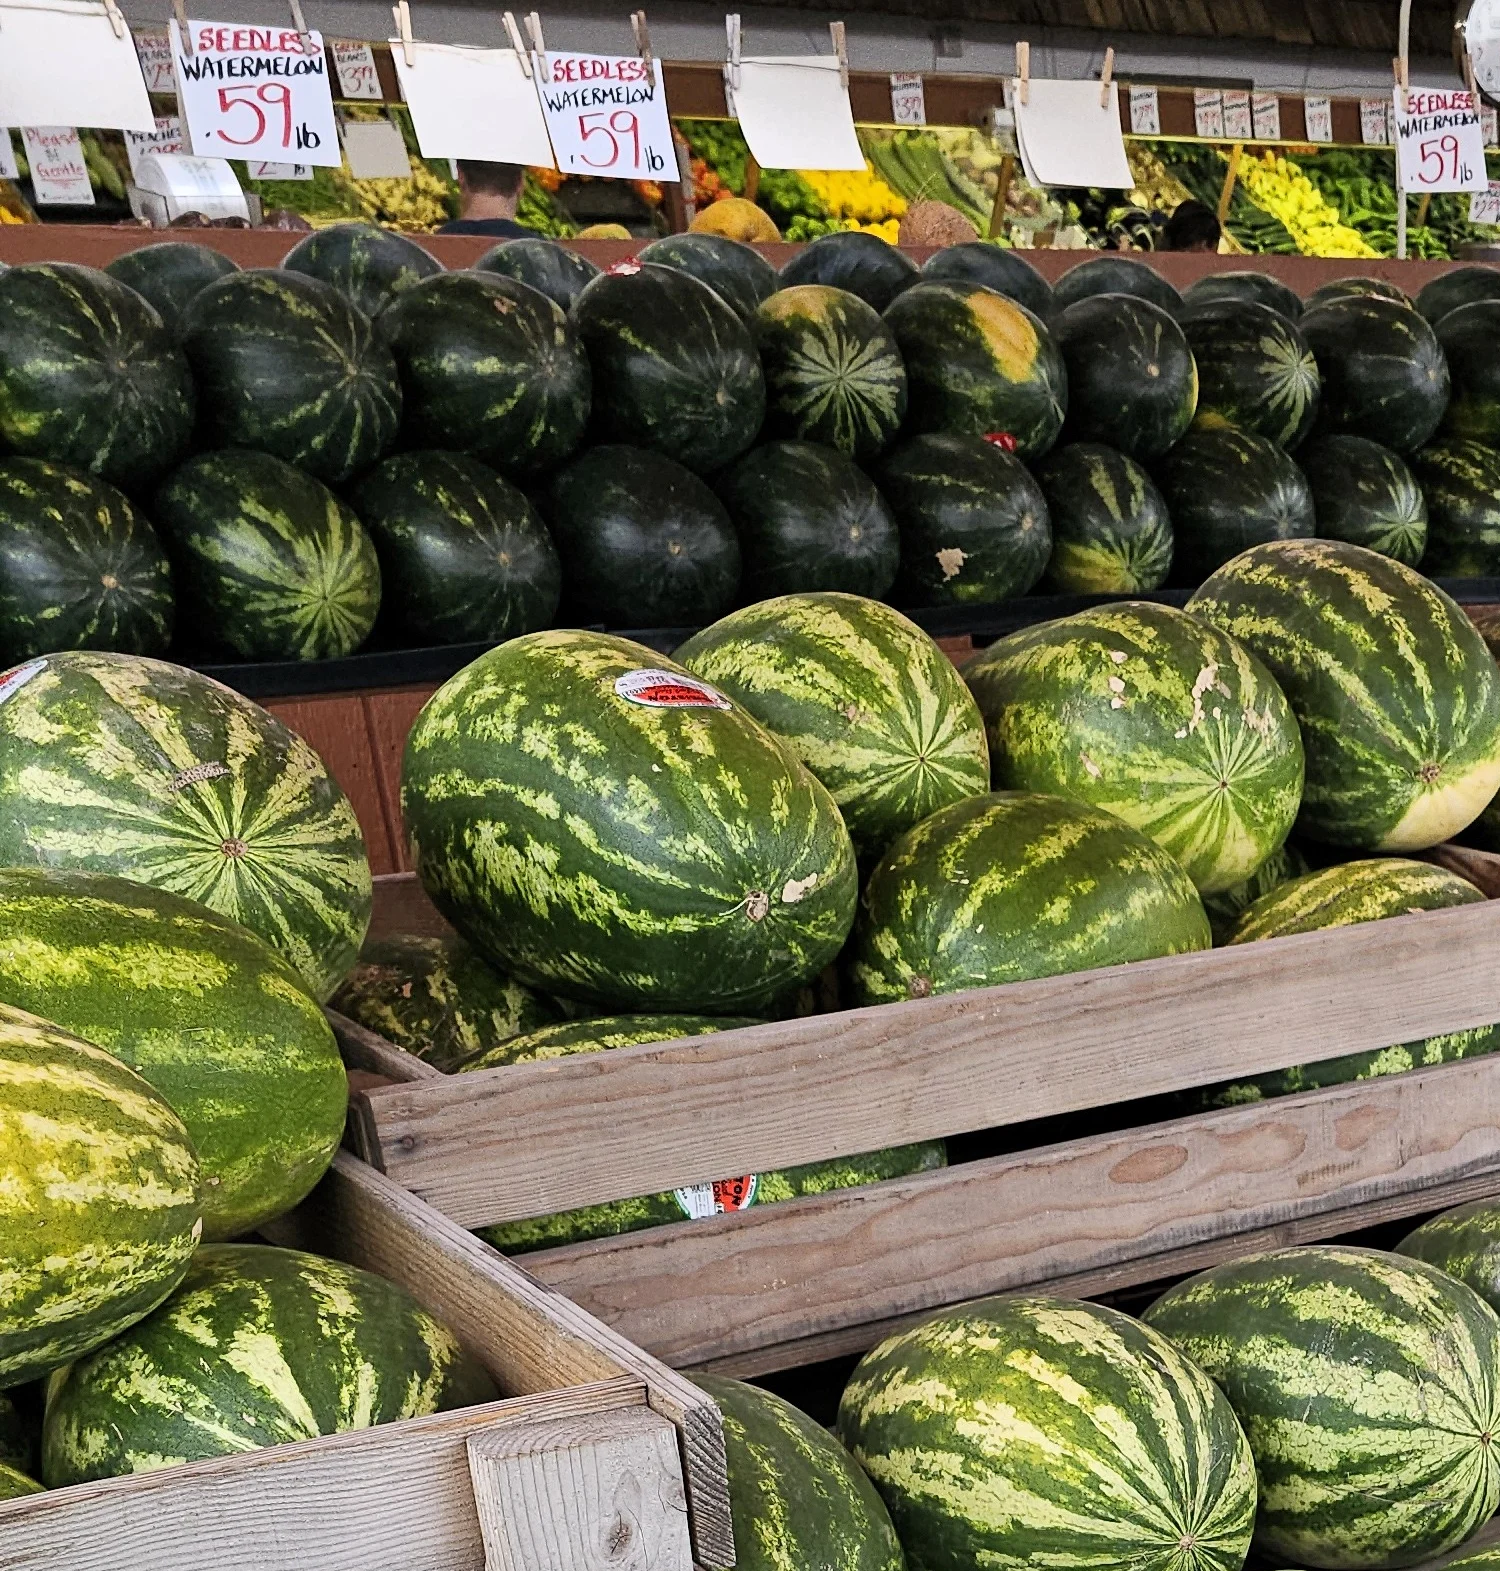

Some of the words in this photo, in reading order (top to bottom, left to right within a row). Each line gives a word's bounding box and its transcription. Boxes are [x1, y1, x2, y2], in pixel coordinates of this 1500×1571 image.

[198, 27, 322, 55] SEEDLESS
[179, 56, 324, 81] WATERMELON
[543, 86, 654, 112] WATERMELON
[1406, 92, 1475, 115] SEEDLESS
[205, 82, 292, 148] .59
[295, 122, 321, 149] lb
[1397, 112, 1480, 138] WATERMELON
[644, 145, 665, 173] lb
[1460, 162, 1474, 185] lb
